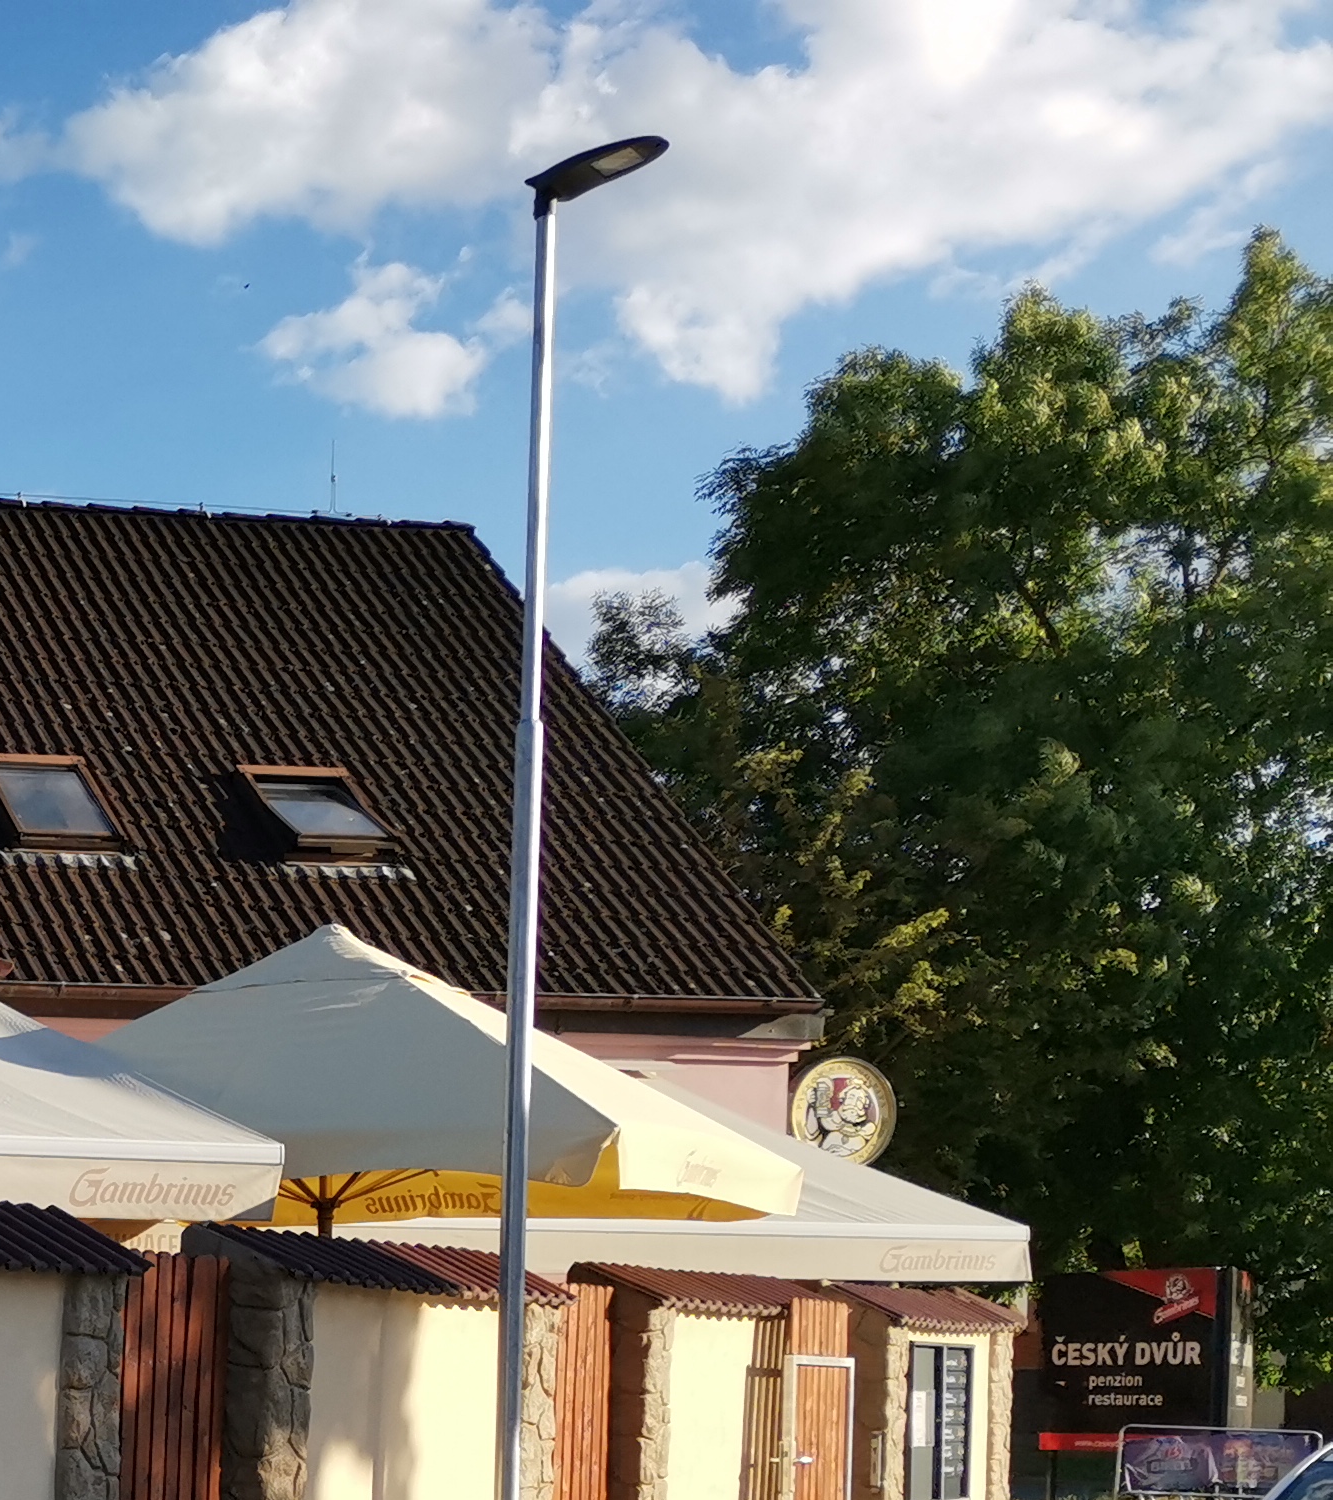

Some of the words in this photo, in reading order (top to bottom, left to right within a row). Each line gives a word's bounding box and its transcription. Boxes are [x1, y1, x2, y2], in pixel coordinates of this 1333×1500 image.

[68, 1166, 237, 1208] Gambrinus
[878, 1244, 997, 1274] Gambrinus
[1051, 1334, 1130, 1366] ČESKÝ
[1134, 1331, 1202, 1366] DVŮR
[1088, 1372, 1143, 1391] penzion
[1088, 1393, 1164, 1406] restaurace
